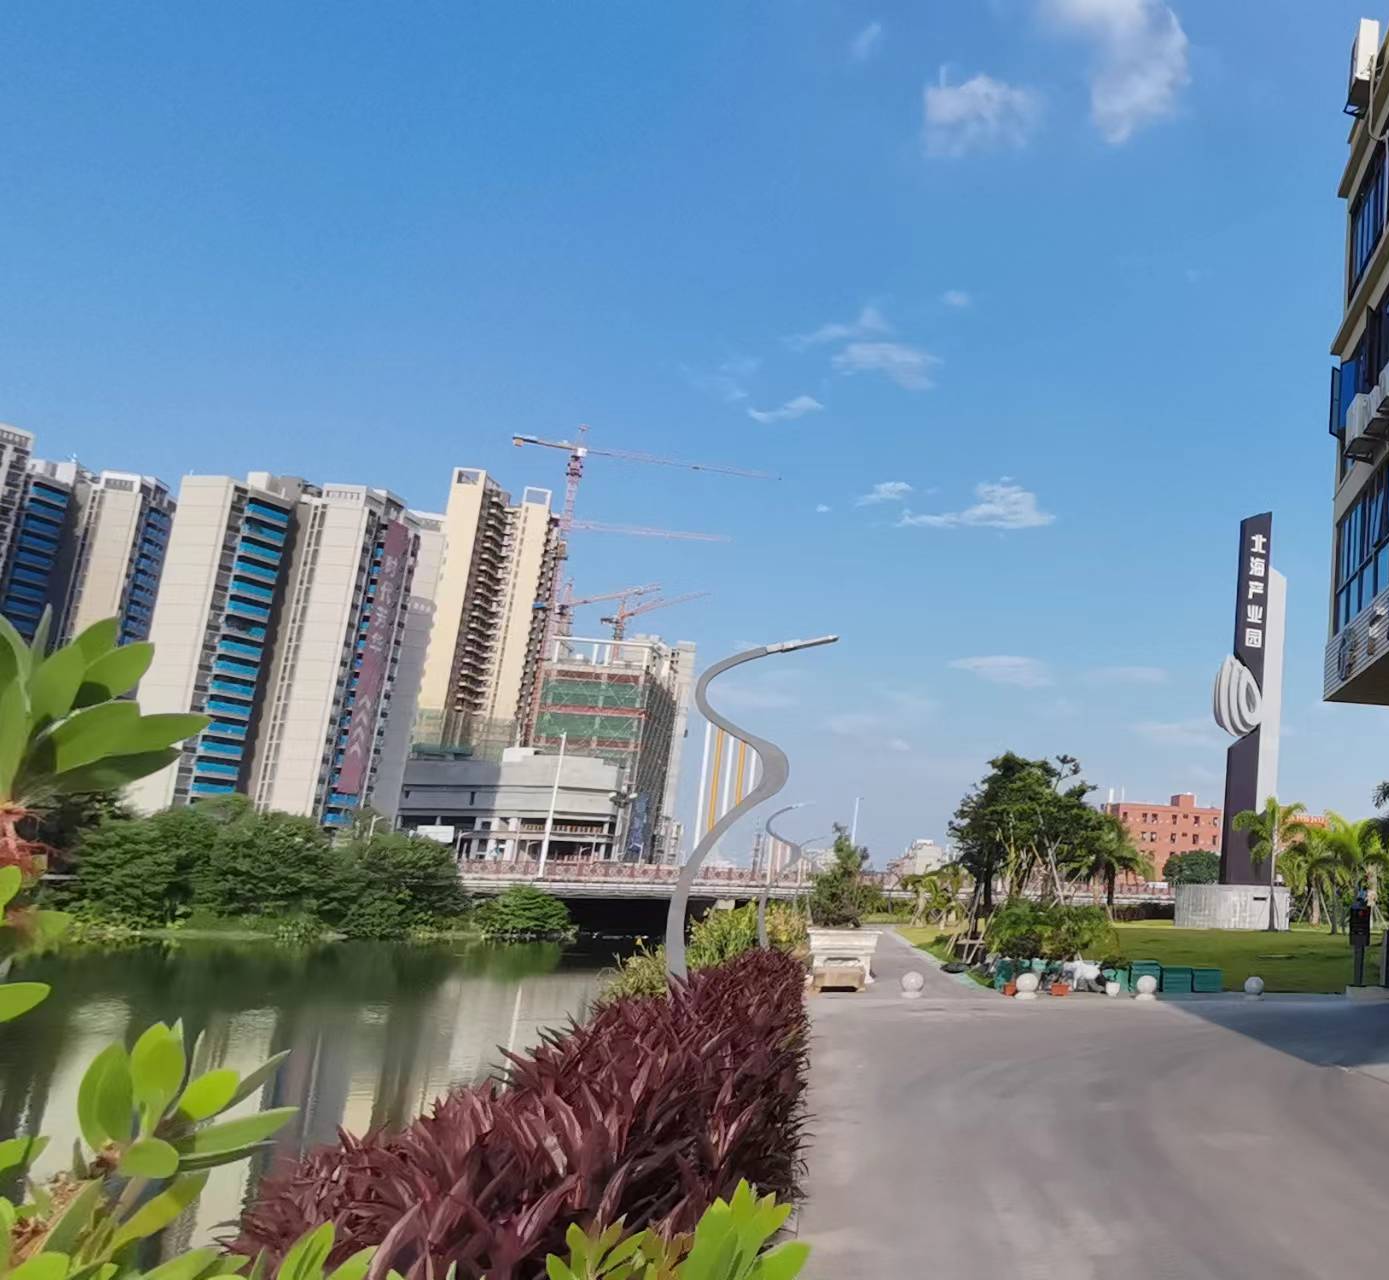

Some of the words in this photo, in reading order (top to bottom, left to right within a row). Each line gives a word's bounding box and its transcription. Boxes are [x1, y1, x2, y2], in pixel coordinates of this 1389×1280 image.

[1244, 533, 1267, 649] 北海产业园
